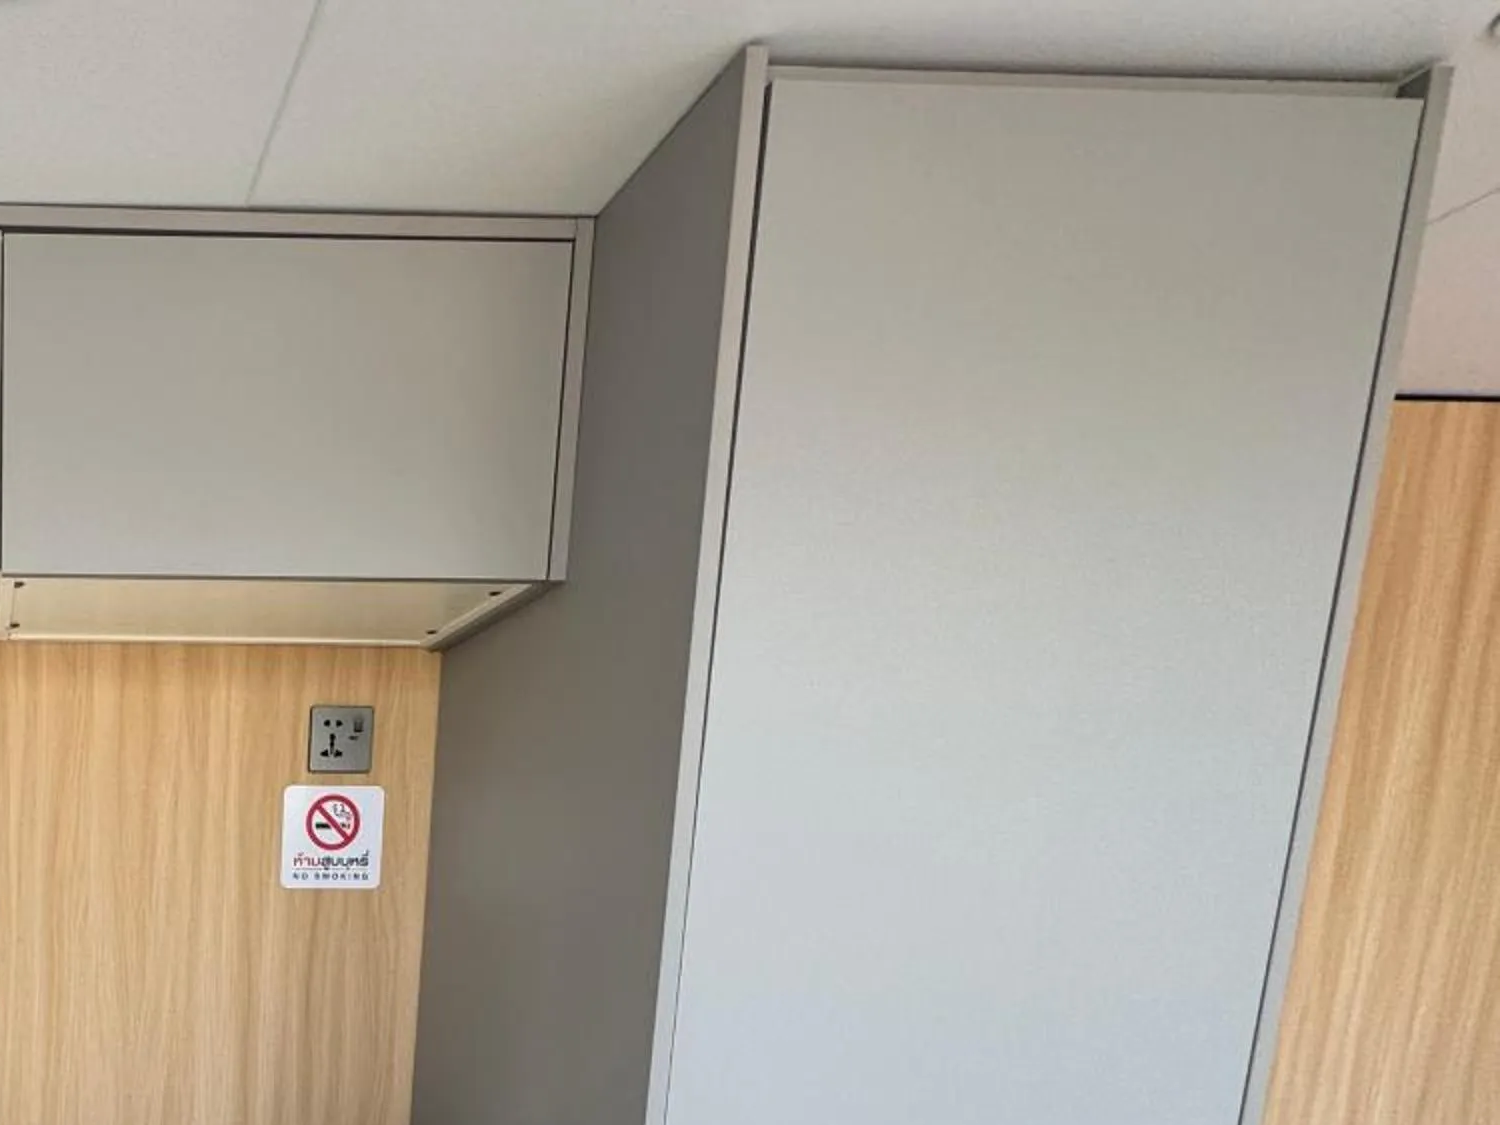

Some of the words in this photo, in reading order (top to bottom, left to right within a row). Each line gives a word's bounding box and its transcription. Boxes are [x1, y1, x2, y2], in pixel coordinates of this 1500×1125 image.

[293, 850, 370, 870] ห้ามสูบบุหรี่
[293, 872, 309, 880] NO
[314, 872, 369, 880] SMOKING
